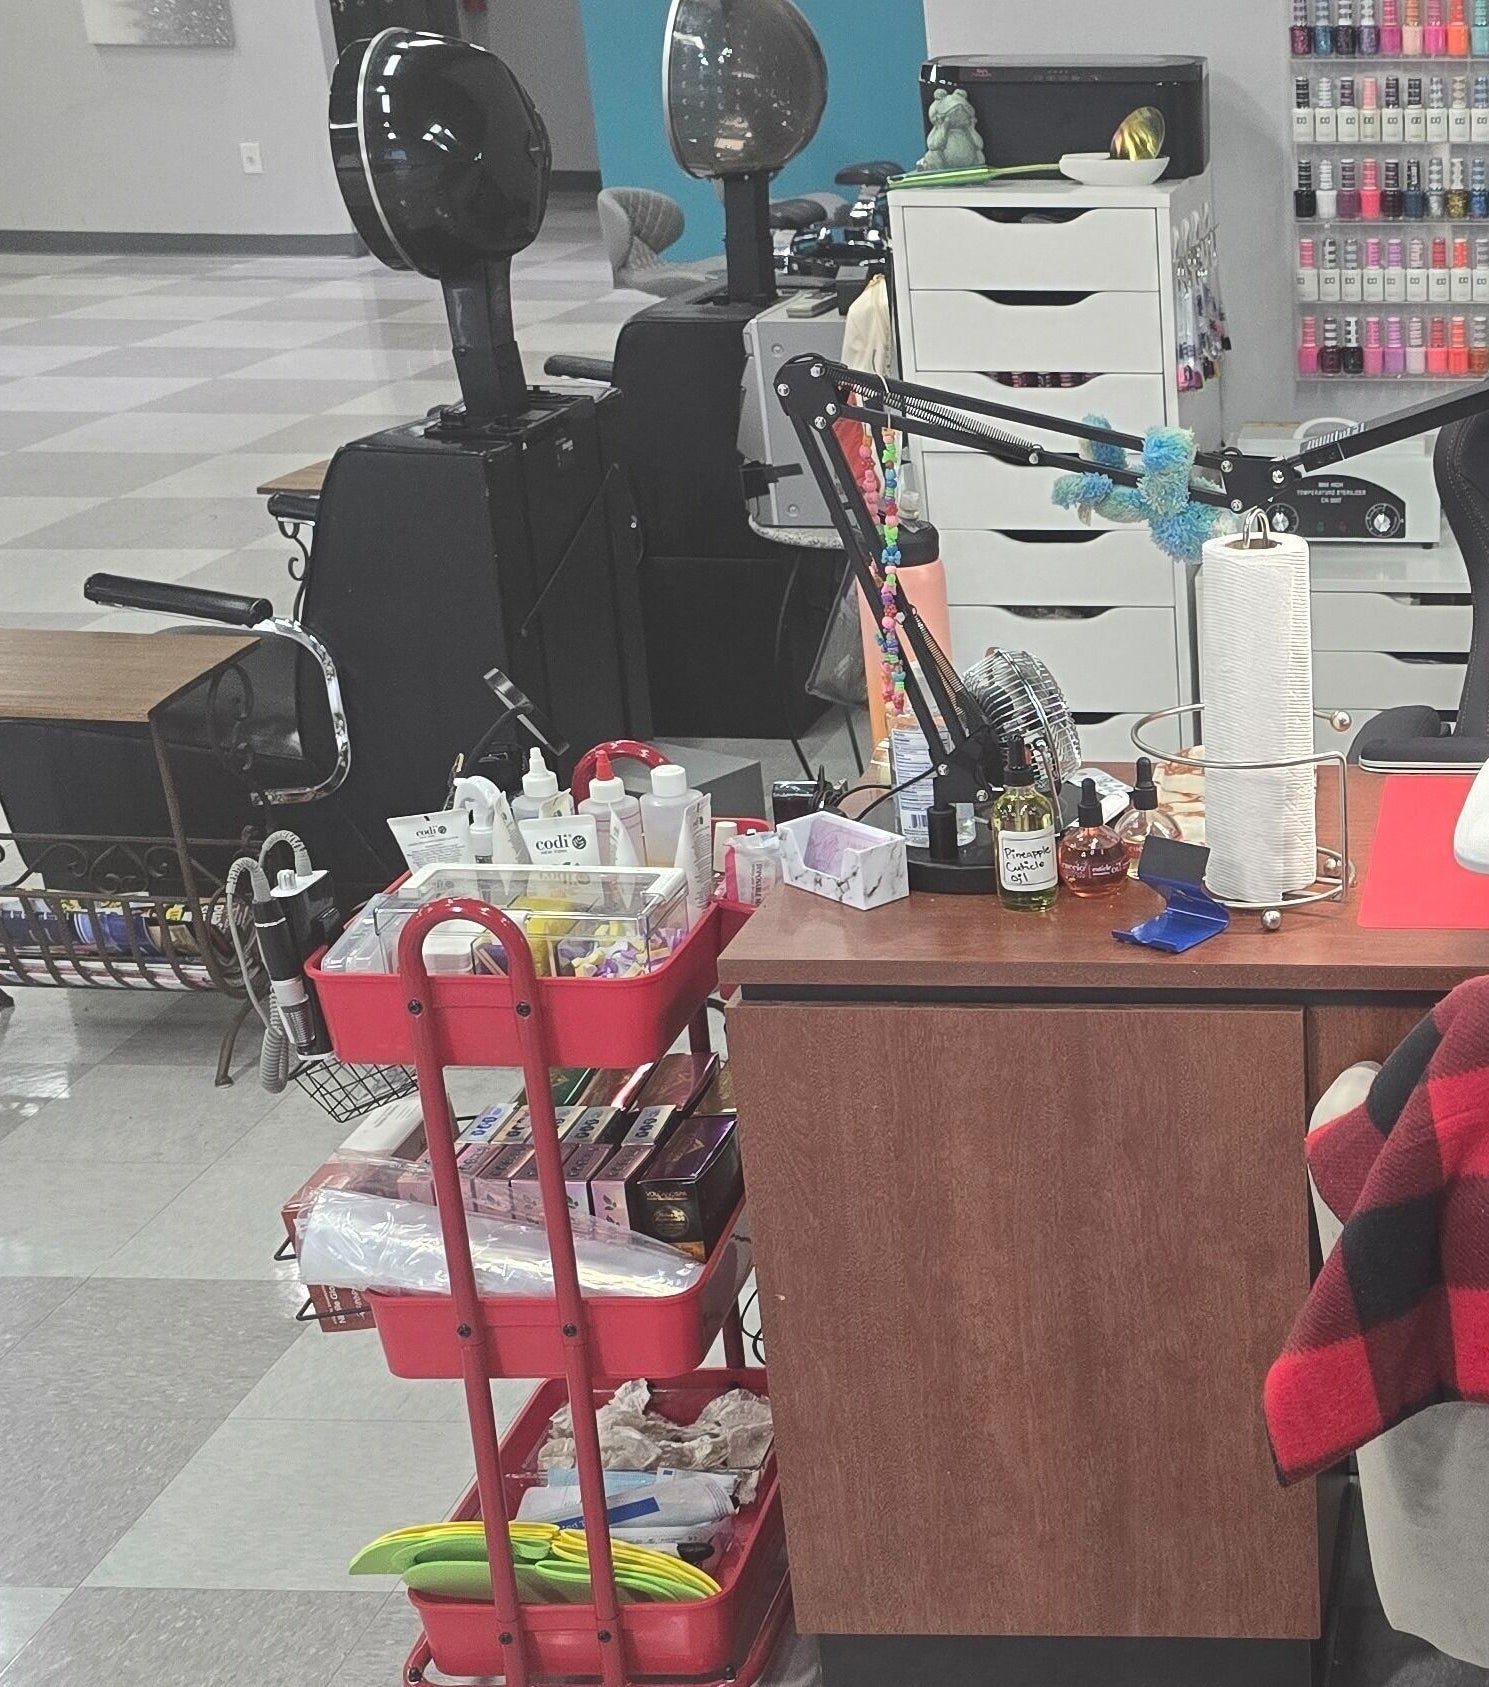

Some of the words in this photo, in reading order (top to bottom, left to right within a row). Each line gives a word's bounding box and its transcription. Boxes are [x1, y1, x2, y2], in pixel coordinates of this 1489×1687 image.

[416, 826, 436, 837] codi
[536, 834, 569, 851] codi
[1004, 846, 1051, 860] Pineapple
[1005, 860, 1045, 872] Cuticle
